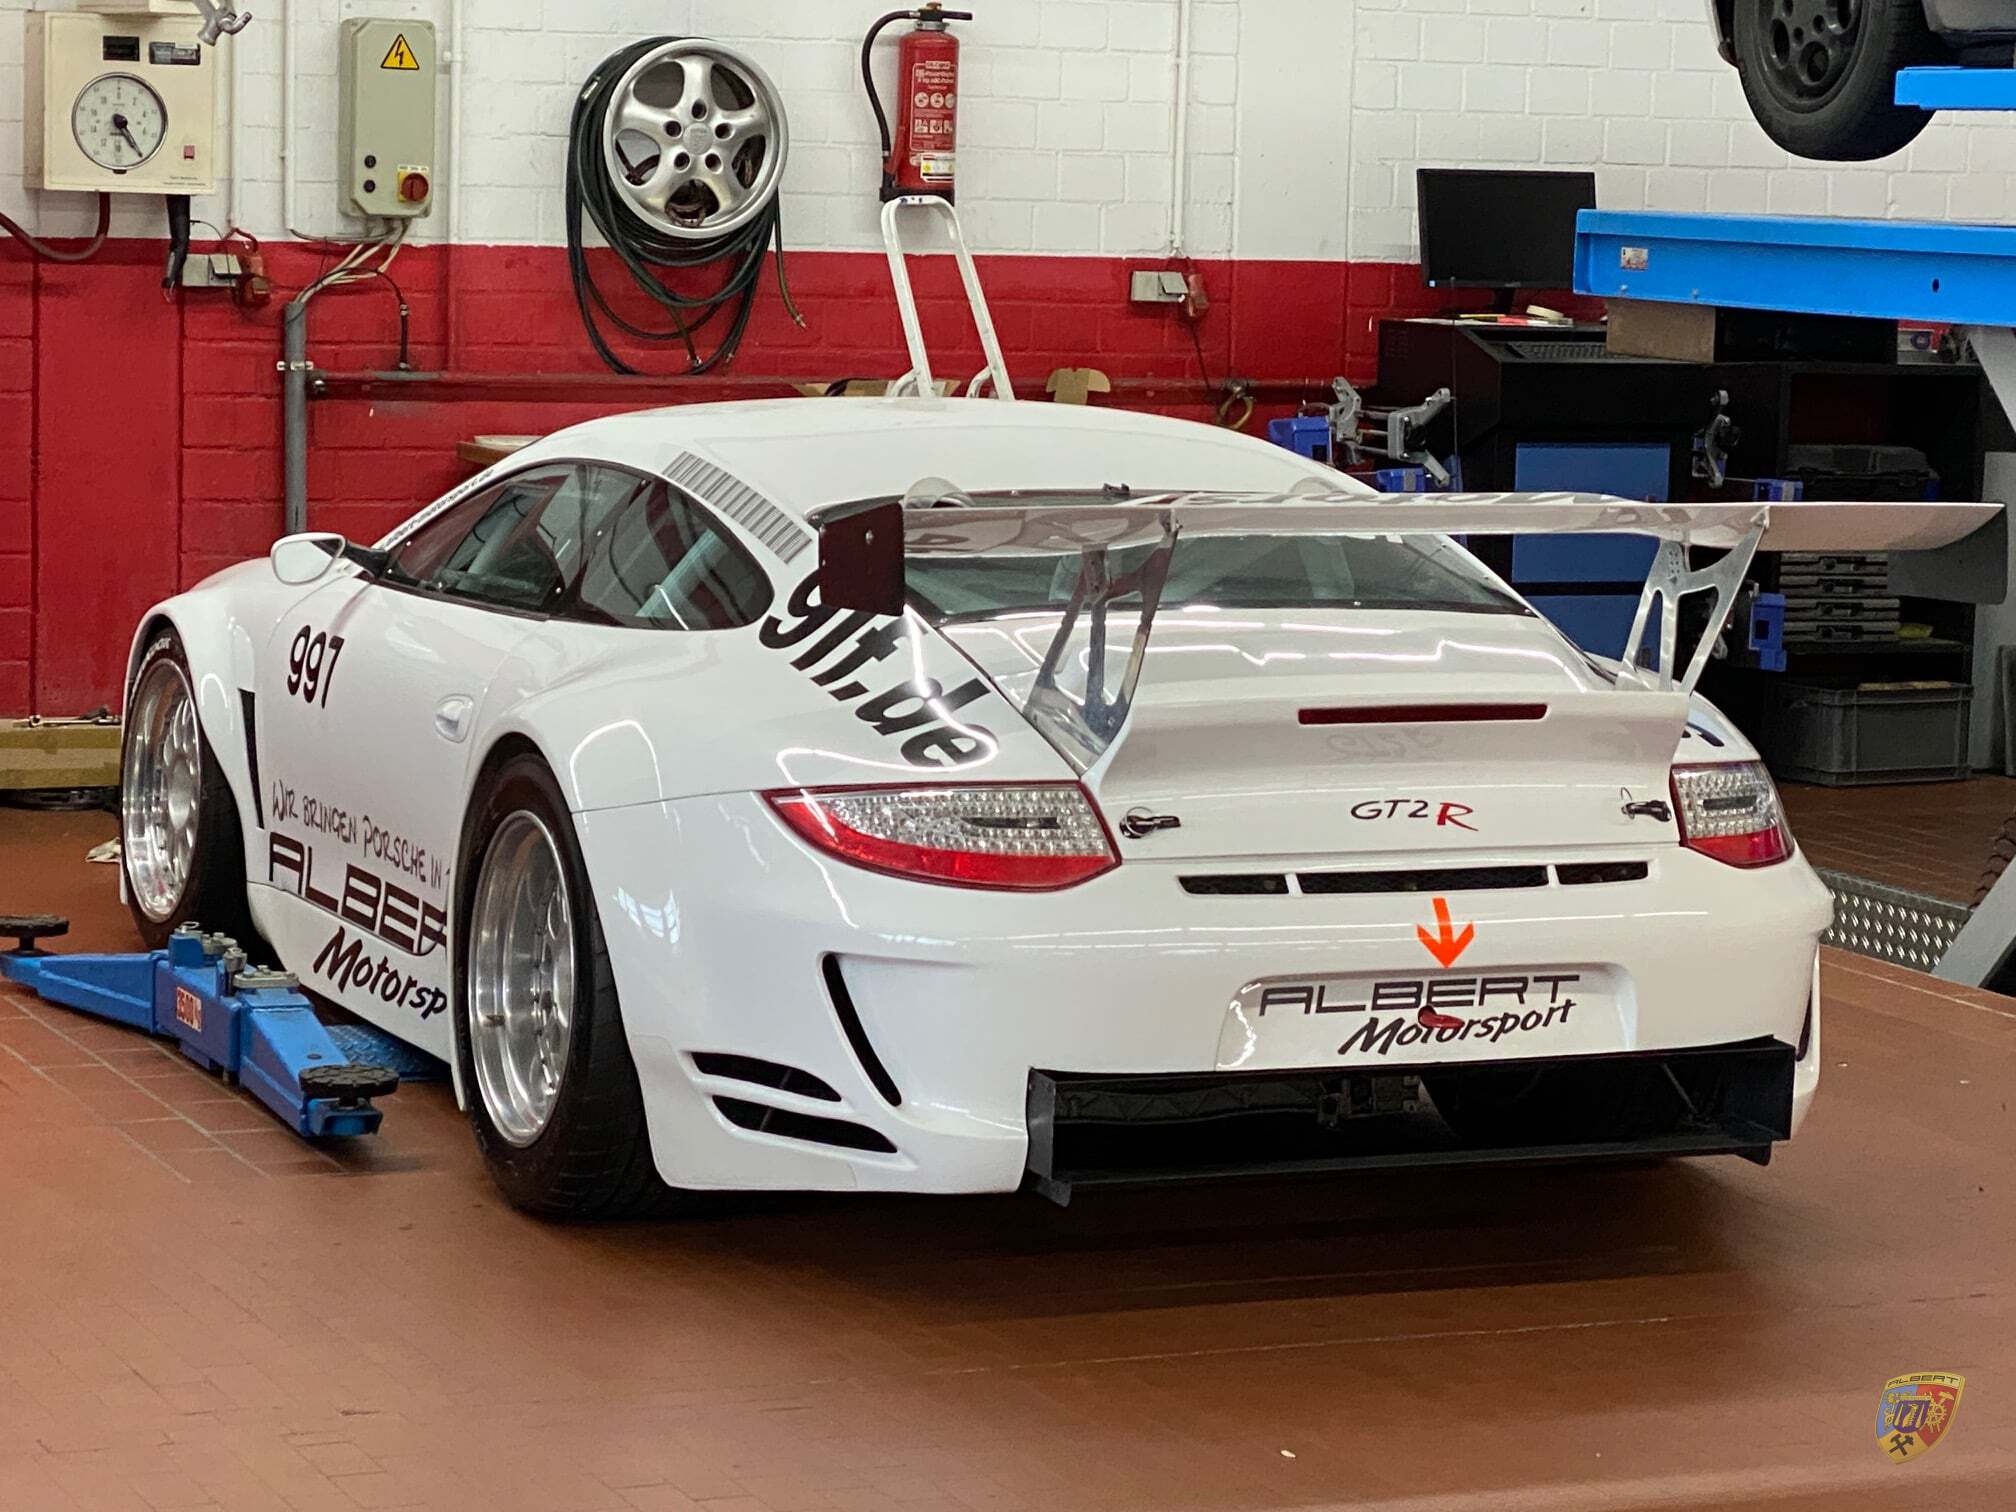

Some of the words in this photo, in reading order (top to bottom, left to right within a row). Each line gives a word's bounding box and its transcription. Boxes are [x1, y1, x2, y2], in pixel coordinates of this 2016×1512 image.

[287, 625, 345, 709] 997
[272, 779, 298, 821] WIR
[303, 795, 357, 844] BRINGEN
[363, 815, 426, 883] PORSCHE
[430, 854, 442, 890] IN
[313, 926, 447, 1020] Motorsp
[1259, 974, 1580, 1016] ALBERT
